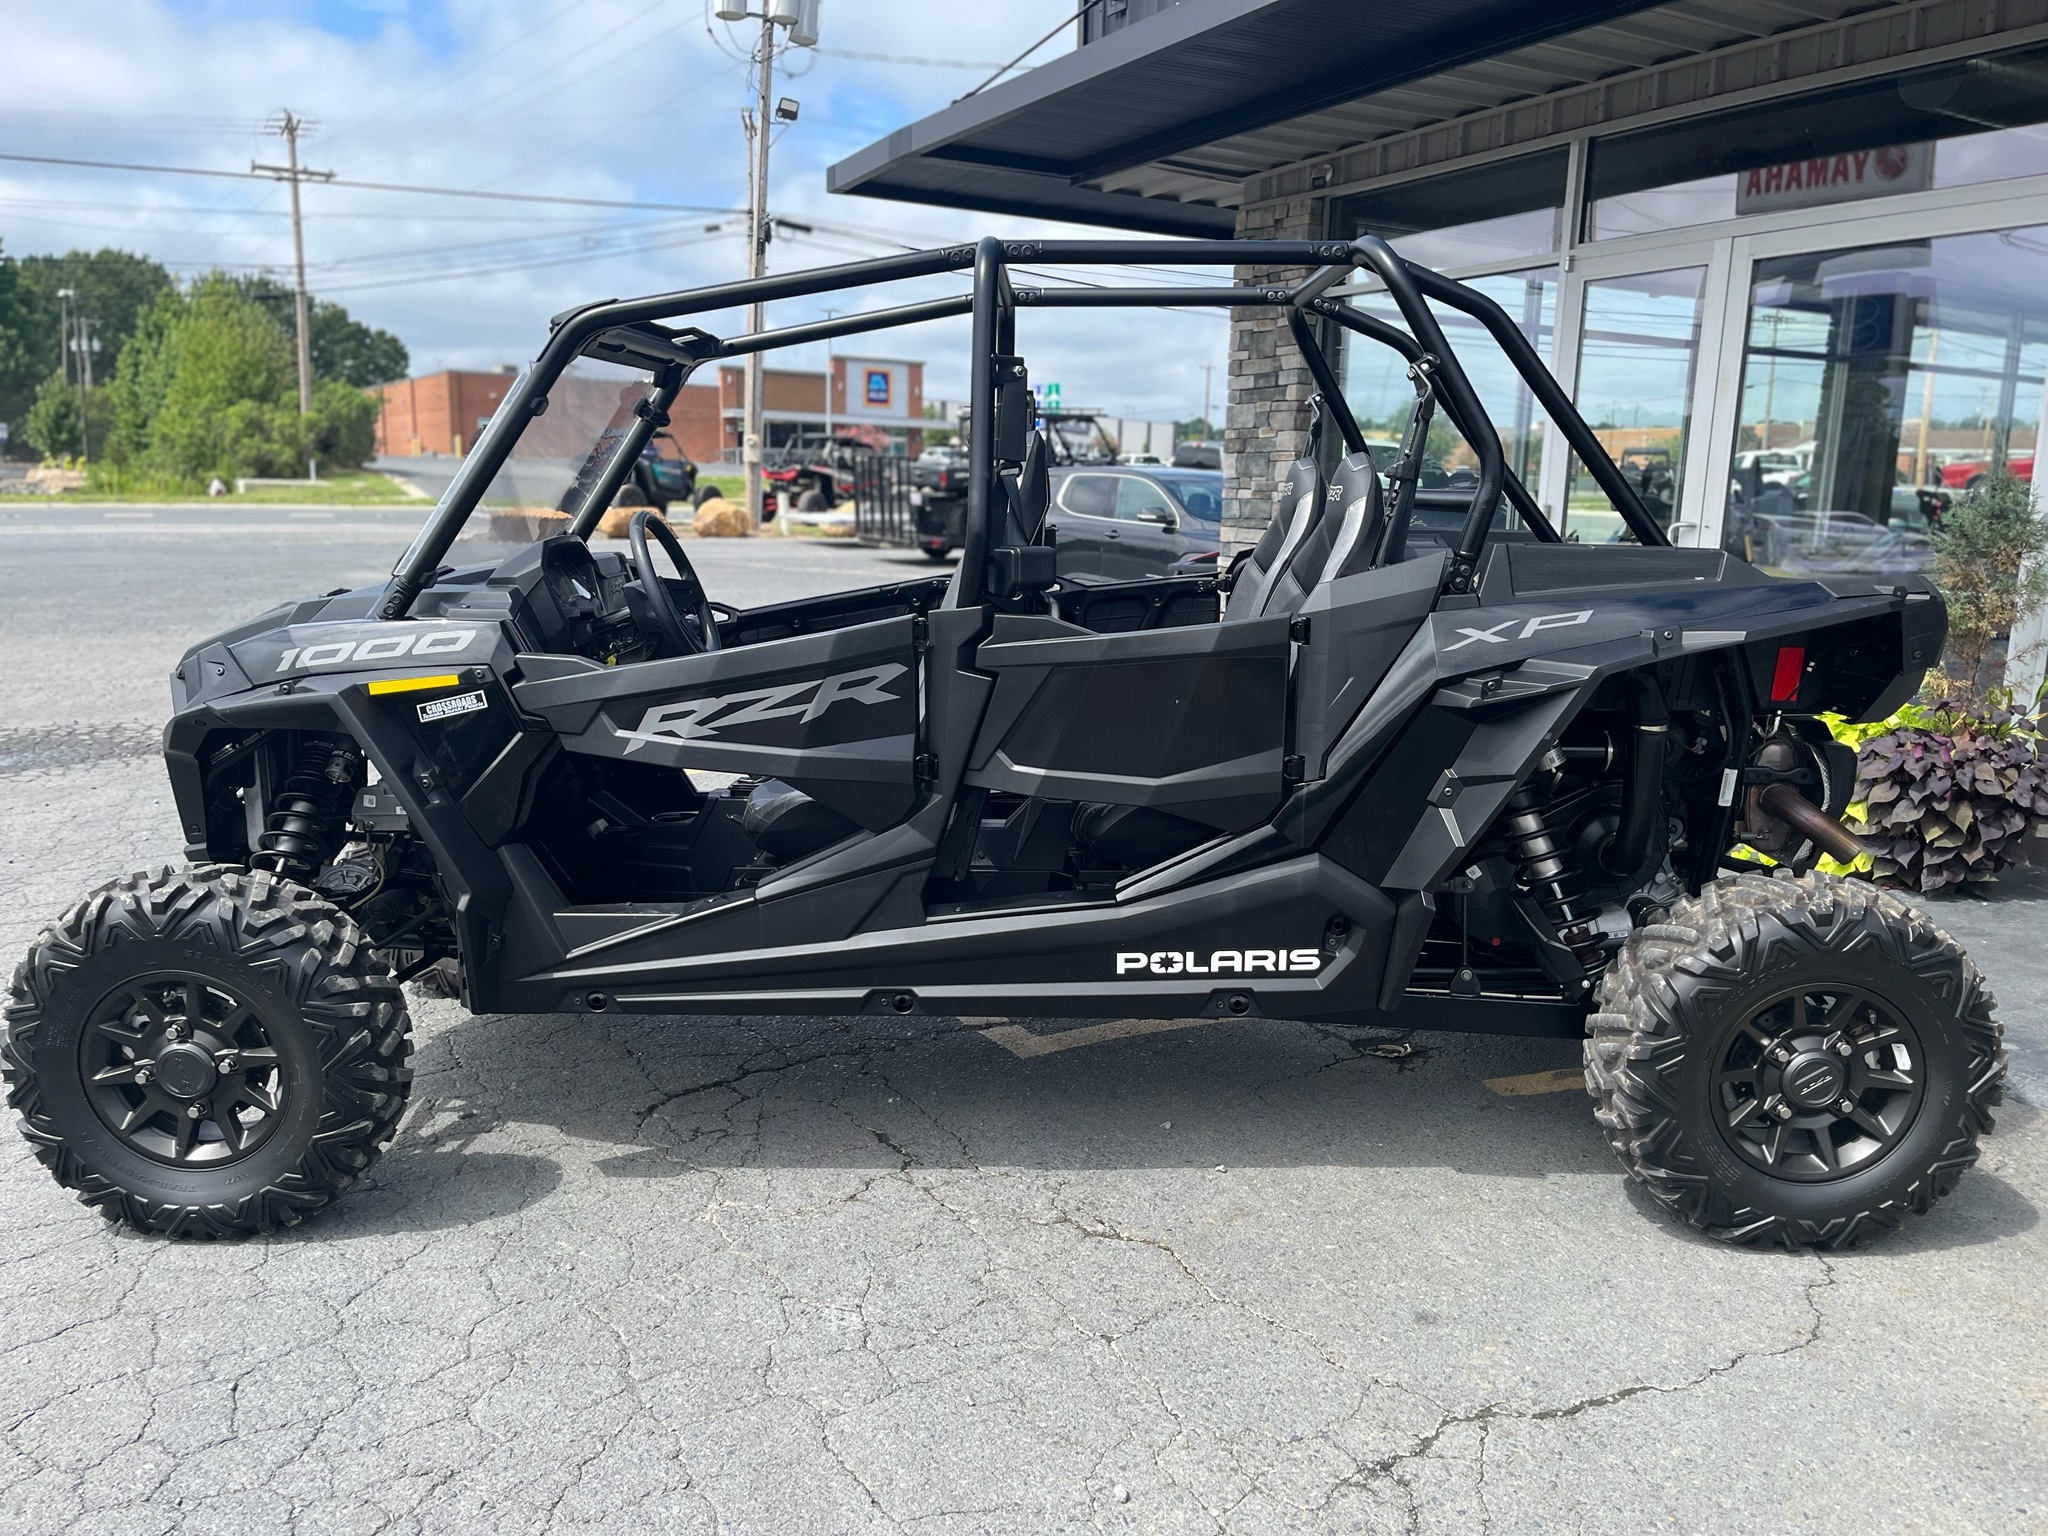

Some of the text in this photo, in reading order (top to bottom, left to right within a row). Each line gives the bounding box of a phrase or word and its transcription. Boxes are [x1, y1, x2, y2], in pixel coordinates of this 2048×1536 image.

[275, 629, 477, 673] 1000
[1441, 609, 1595, 652] XP
[425, 695, 477, 714] CROSSROADS
[622, 662, 909, 756] RZR
[1116, 948, 1321, 975] POLARIS
